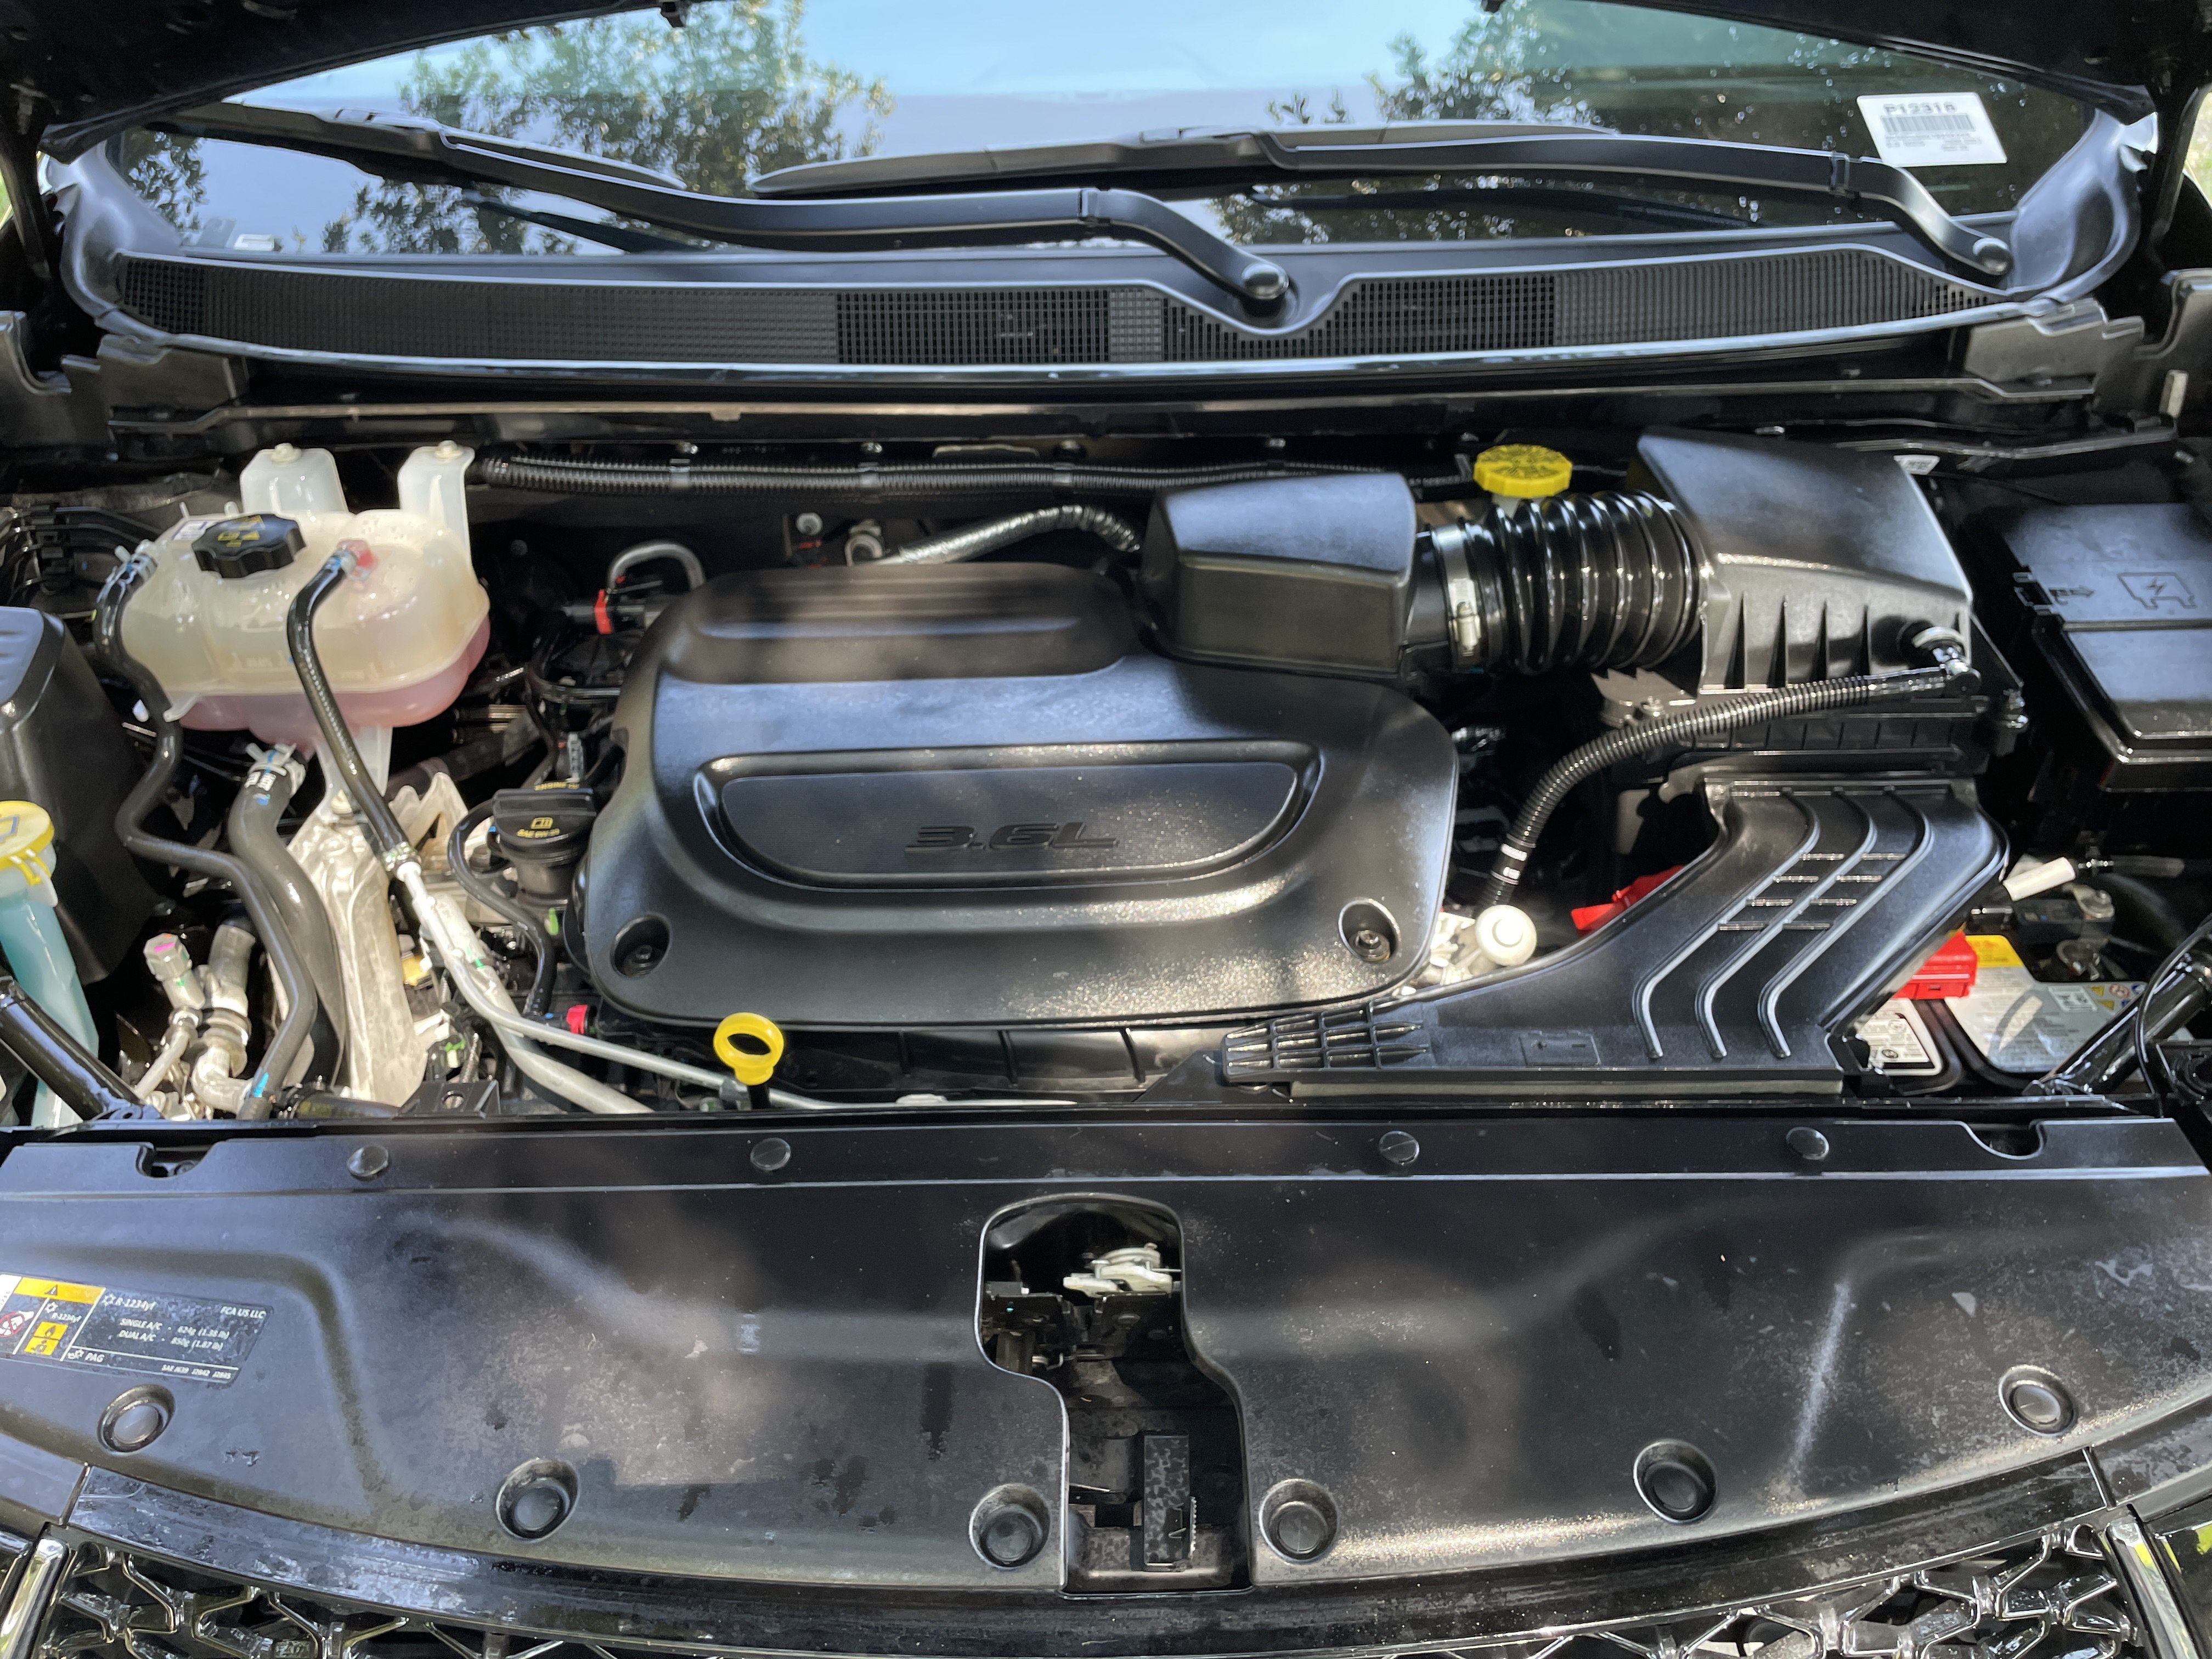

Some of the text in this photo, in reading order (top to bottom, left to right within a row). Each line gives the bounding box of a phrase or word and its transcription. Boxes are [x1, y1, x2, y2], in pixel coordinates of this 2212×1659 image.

[905, 822, 1117, 851] 3.6L
[115, 1297, 157, 1311] R-1234yf
[52, 1312, 82, 1323] R-1234yf
[221, 1306, 267, 1319] FCA US LLC
[120, 1318, 147, 1328] SINGLE
[146, 1321, 163, 1330] A/C
[118, 1330, 139, 1340] DUAL
[139, 1333, 157, 1342] A/C
[84, 1352, 105, 1363] PAG
